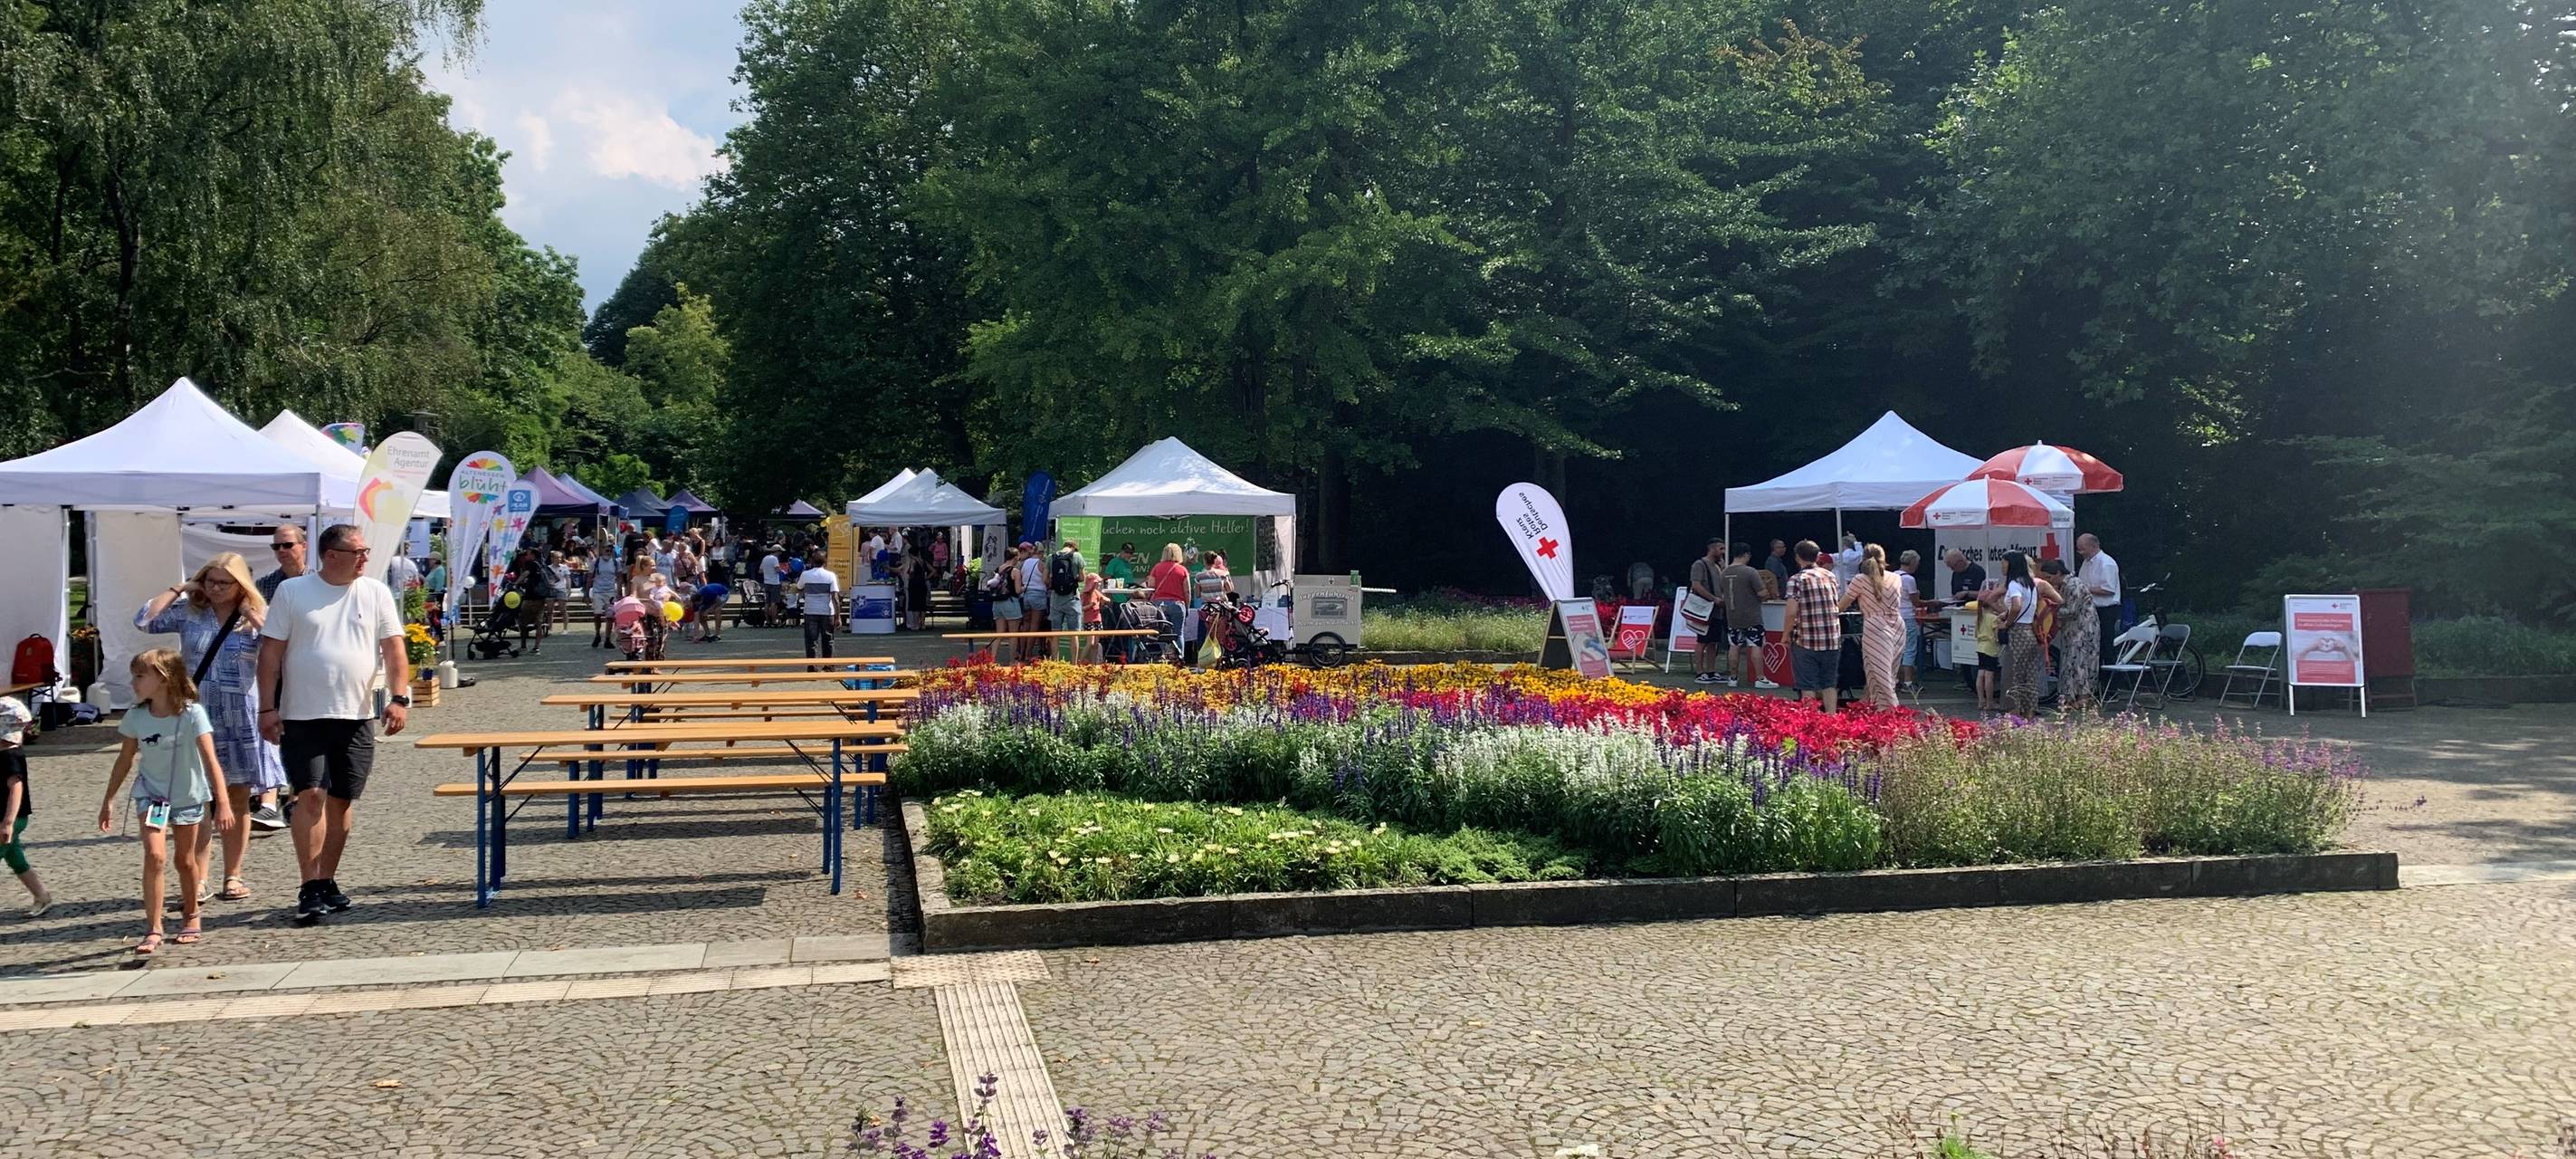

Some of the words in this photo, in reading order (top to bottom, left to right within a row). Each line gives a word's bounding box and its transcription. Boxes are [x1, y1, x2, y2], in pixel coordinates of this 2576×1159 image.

[386, 445, 430, 458] Ehrenamt
[393, 457, 428, 469] Agentur
[459, 474, 507, 493] blüht
[1102, 521, 1136, 535] uchen
[1140, 520, 1166, 535] noch
[1169, 519, 1207, 534] aktive
[1211, 518, 1250, 534] Helfer!
